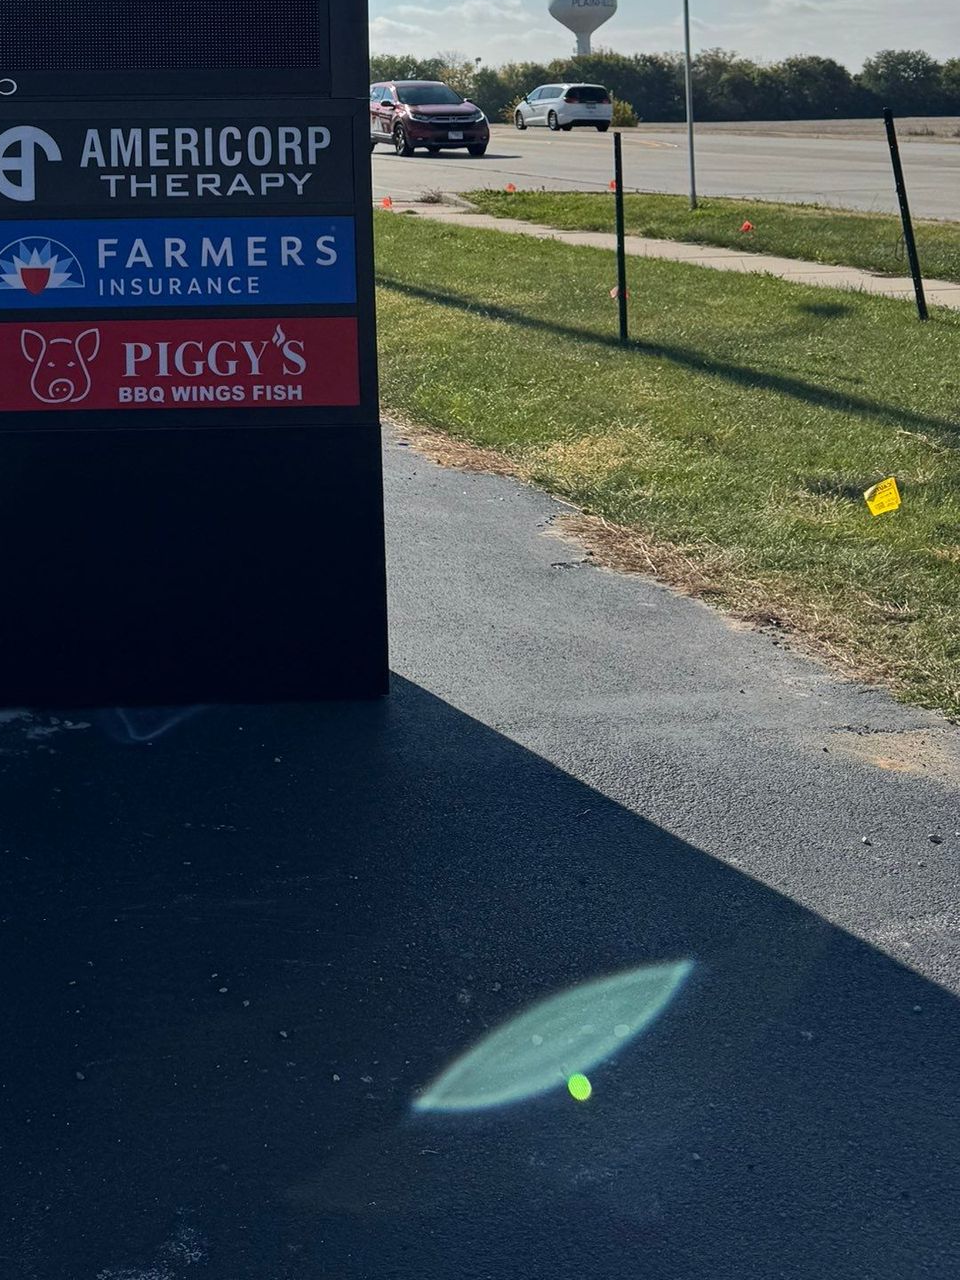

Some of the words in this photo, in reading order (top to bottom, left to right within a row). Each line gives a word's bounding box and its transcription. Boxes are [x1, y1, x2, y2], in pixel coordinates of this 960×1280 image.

[79, 125, 332, 168] AMERICORP
[100, 171, 314, 198] THERAPY
[97, 234, 339, 269] FARMERS
[98, 276, 261, 297] INSURANCE
[121, 324, 308, 378] PIGGY'S
[118, 386, 165, 404] BBQ
[171, 385, 246, 402] WINGS
[252, 384, 304, 401] FISH
